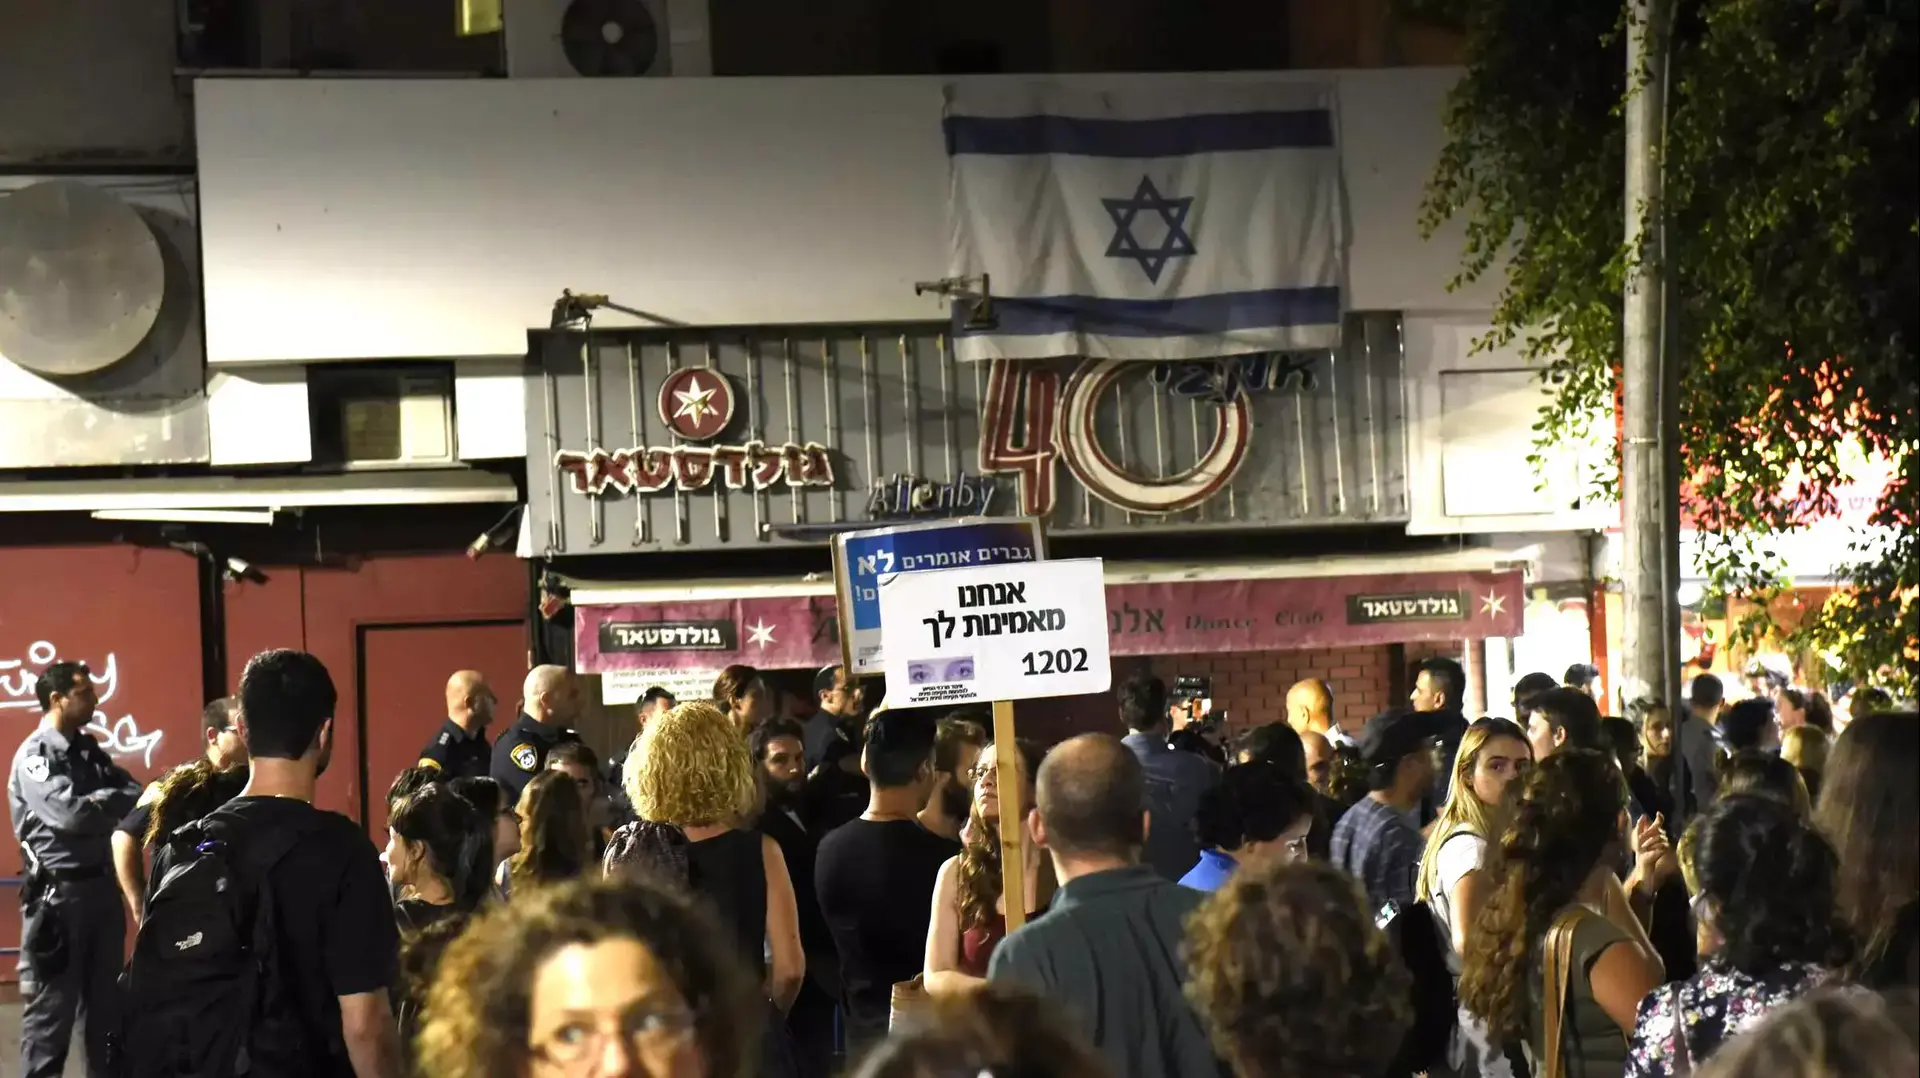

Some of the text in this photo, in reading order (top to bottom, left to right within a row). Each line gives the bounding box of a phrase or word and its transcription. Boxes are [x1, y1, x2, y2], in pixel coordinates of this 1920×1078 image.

[979, 358, 1254, 516] 40
[554, 441, 834, 494] גולדסטאר
[868, 471, 995, 516] Allenby
[857, 547, 1033, 576] גברים אומרים לא
[957, 581, 1027, 608] אנחנו
[922, 608, 1066, 648] מאמינות לך
[1110, 600, 1165, 634] אלנ
[616, 626, 721, 646] גולדסטאר
[1022, 647, 1088, 676] 1202
